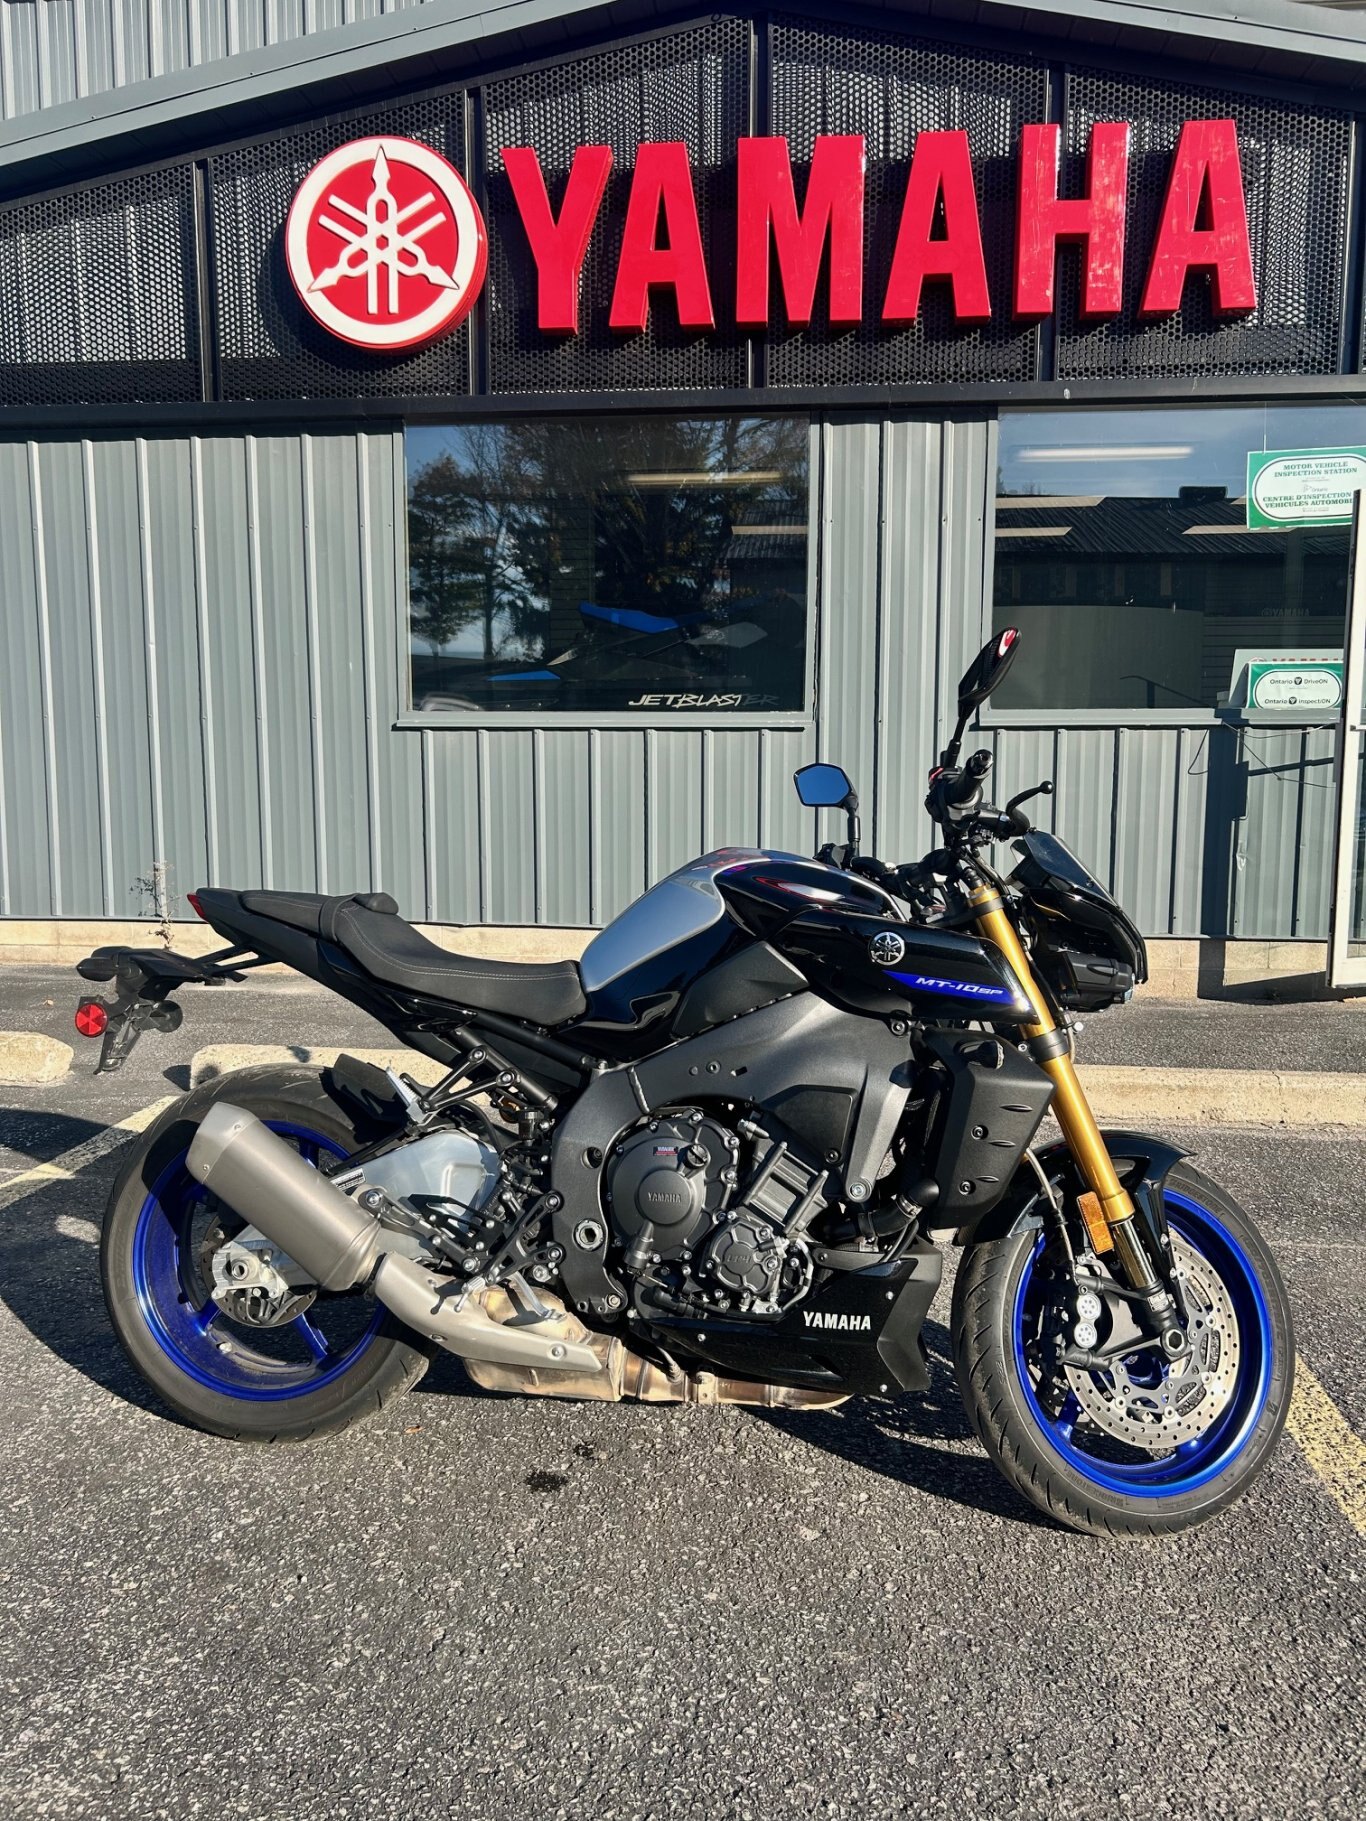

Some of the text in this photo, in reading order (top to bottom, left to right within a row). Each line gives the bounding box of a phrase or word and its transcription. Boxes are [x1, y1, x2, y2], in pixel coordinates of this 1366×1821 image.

[501, 119, 1258, 334] YAMAHA
[1274, 467, 1358, 478] INSPECTION STATION
[1310, 498, 1353, 506] AUTOMOBI
[647, 1191, 682, 1203] YAMAHA
[803, 1310, 871, 1331] YAMAHA
